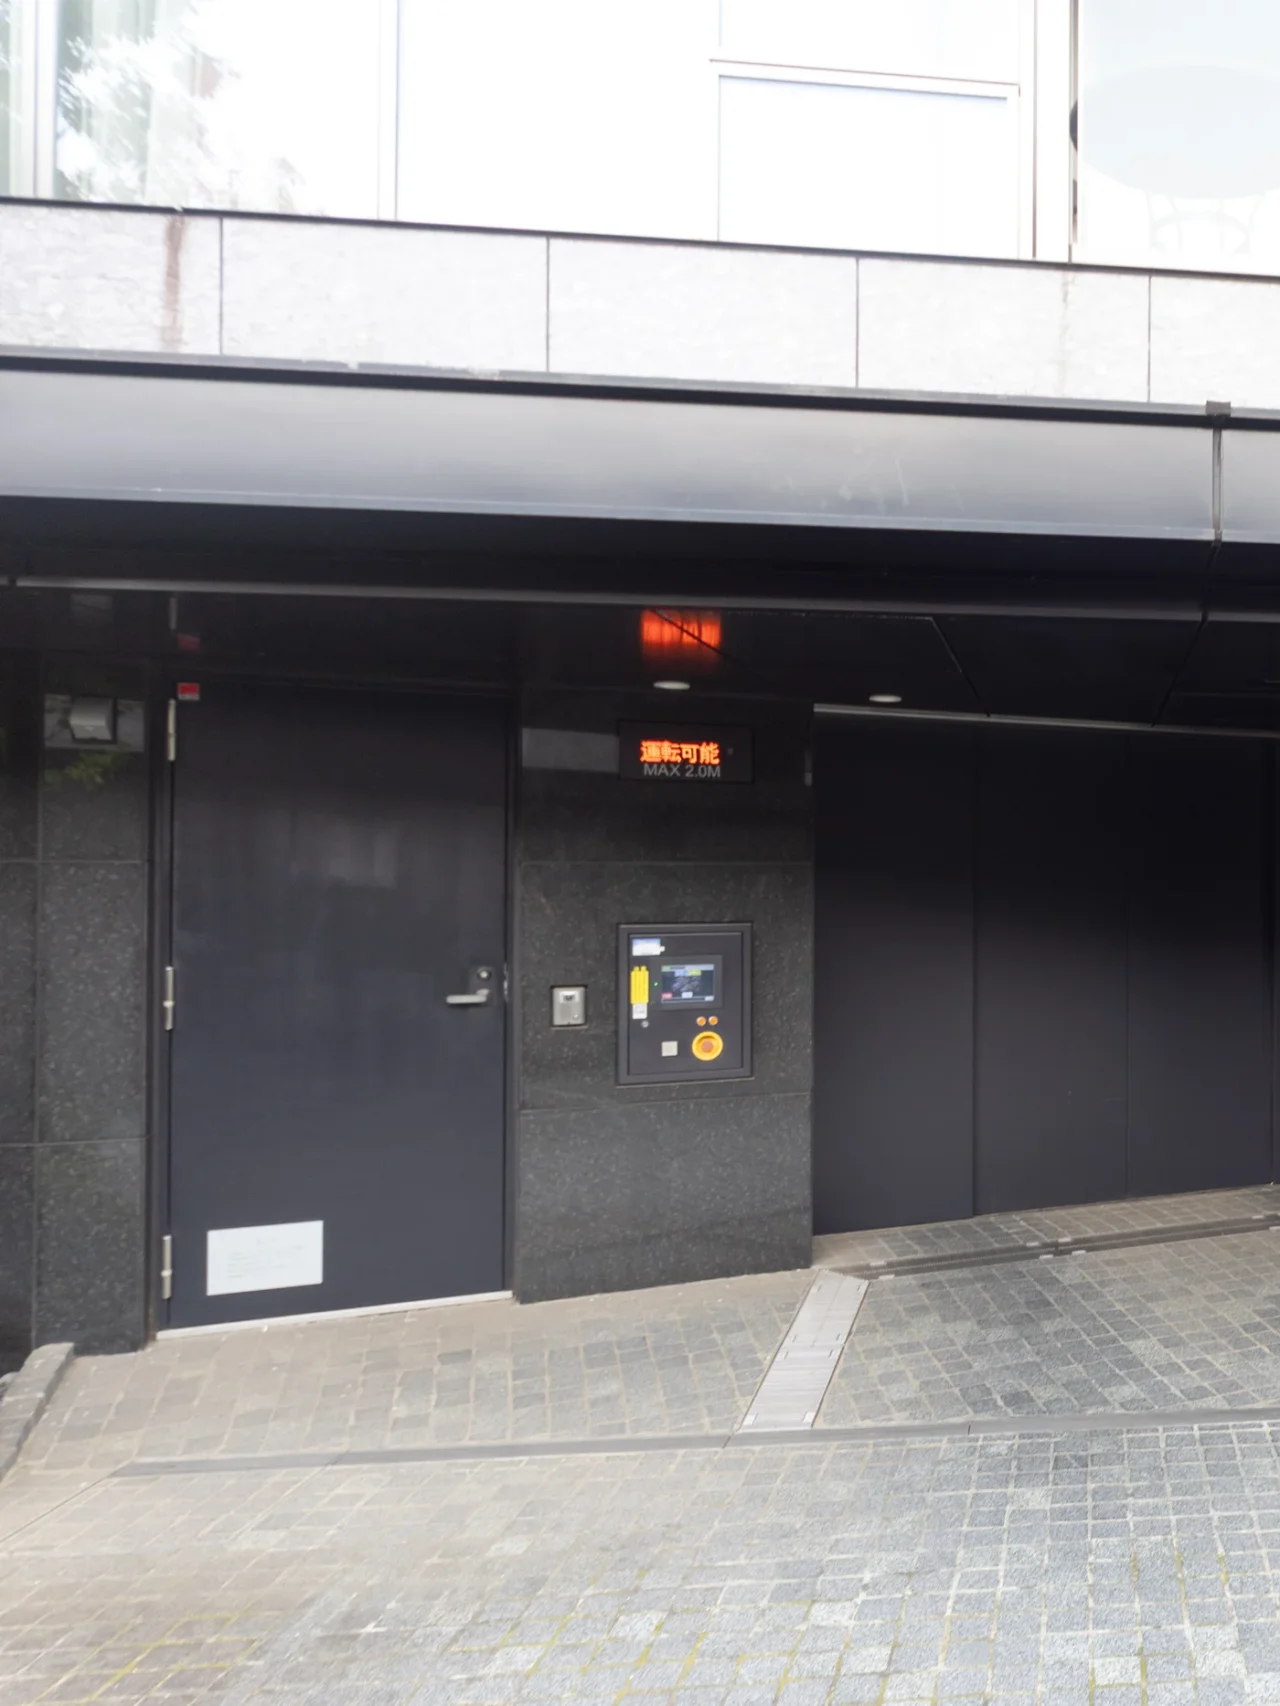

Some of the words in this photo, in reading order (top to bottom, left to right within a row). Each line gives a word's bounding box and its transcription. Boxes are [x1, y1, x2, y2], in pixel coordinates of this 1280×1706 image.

[640, 740, 720, 765] 運転可能
[643, 764, 680, 777] MAX
[685, 765, 721, 778] 2.0M
